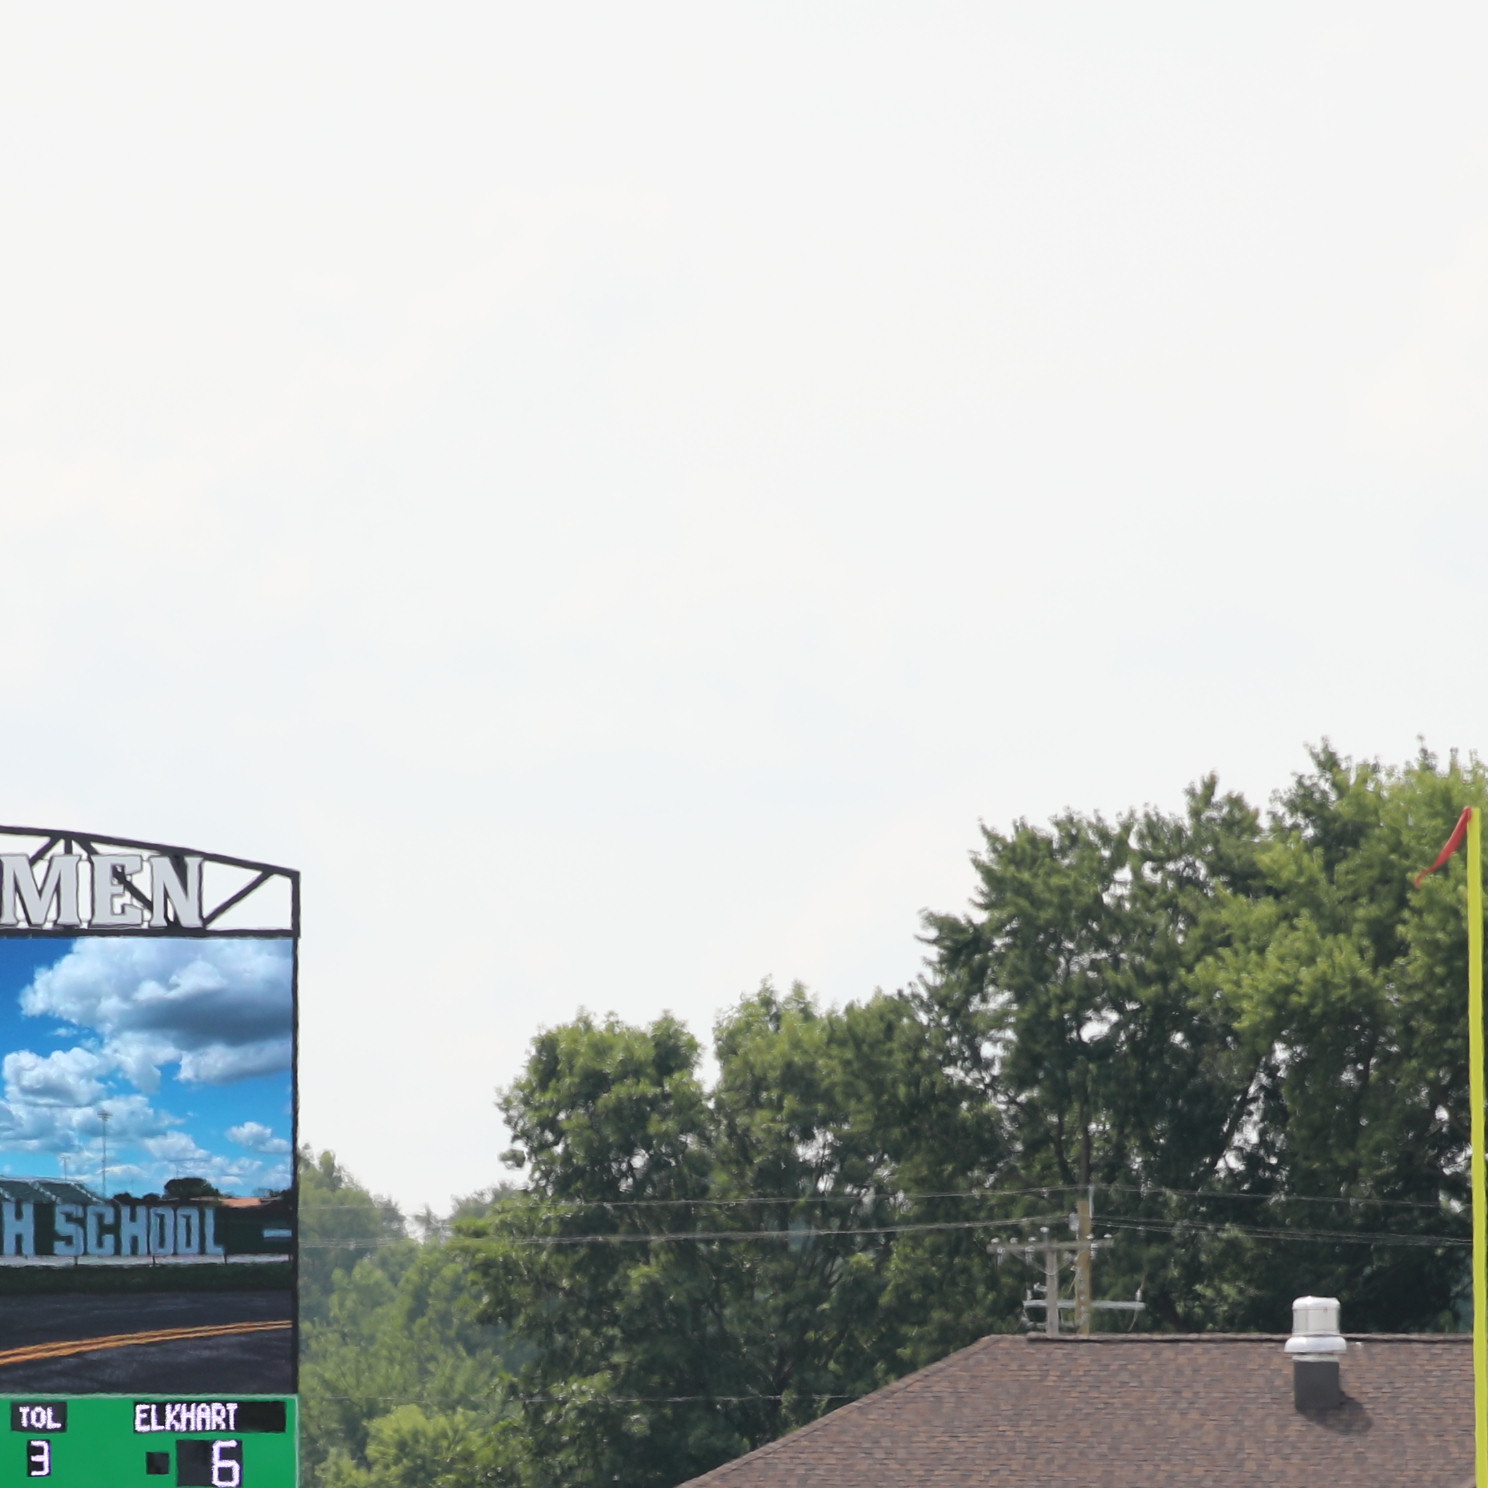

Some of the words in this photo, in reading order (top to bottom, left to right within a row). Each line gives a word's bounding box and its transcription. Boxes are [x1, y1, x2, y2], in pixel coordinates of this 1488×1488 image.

[53, 1202, 226, 1257] SCHOOL
[19, 1405, 61, 1429] TOL
[134, 1402, 238, 1432] ELKHART
[29, 1439, 50, 1477] 3
[211, 1440, 241, 1488] 6
